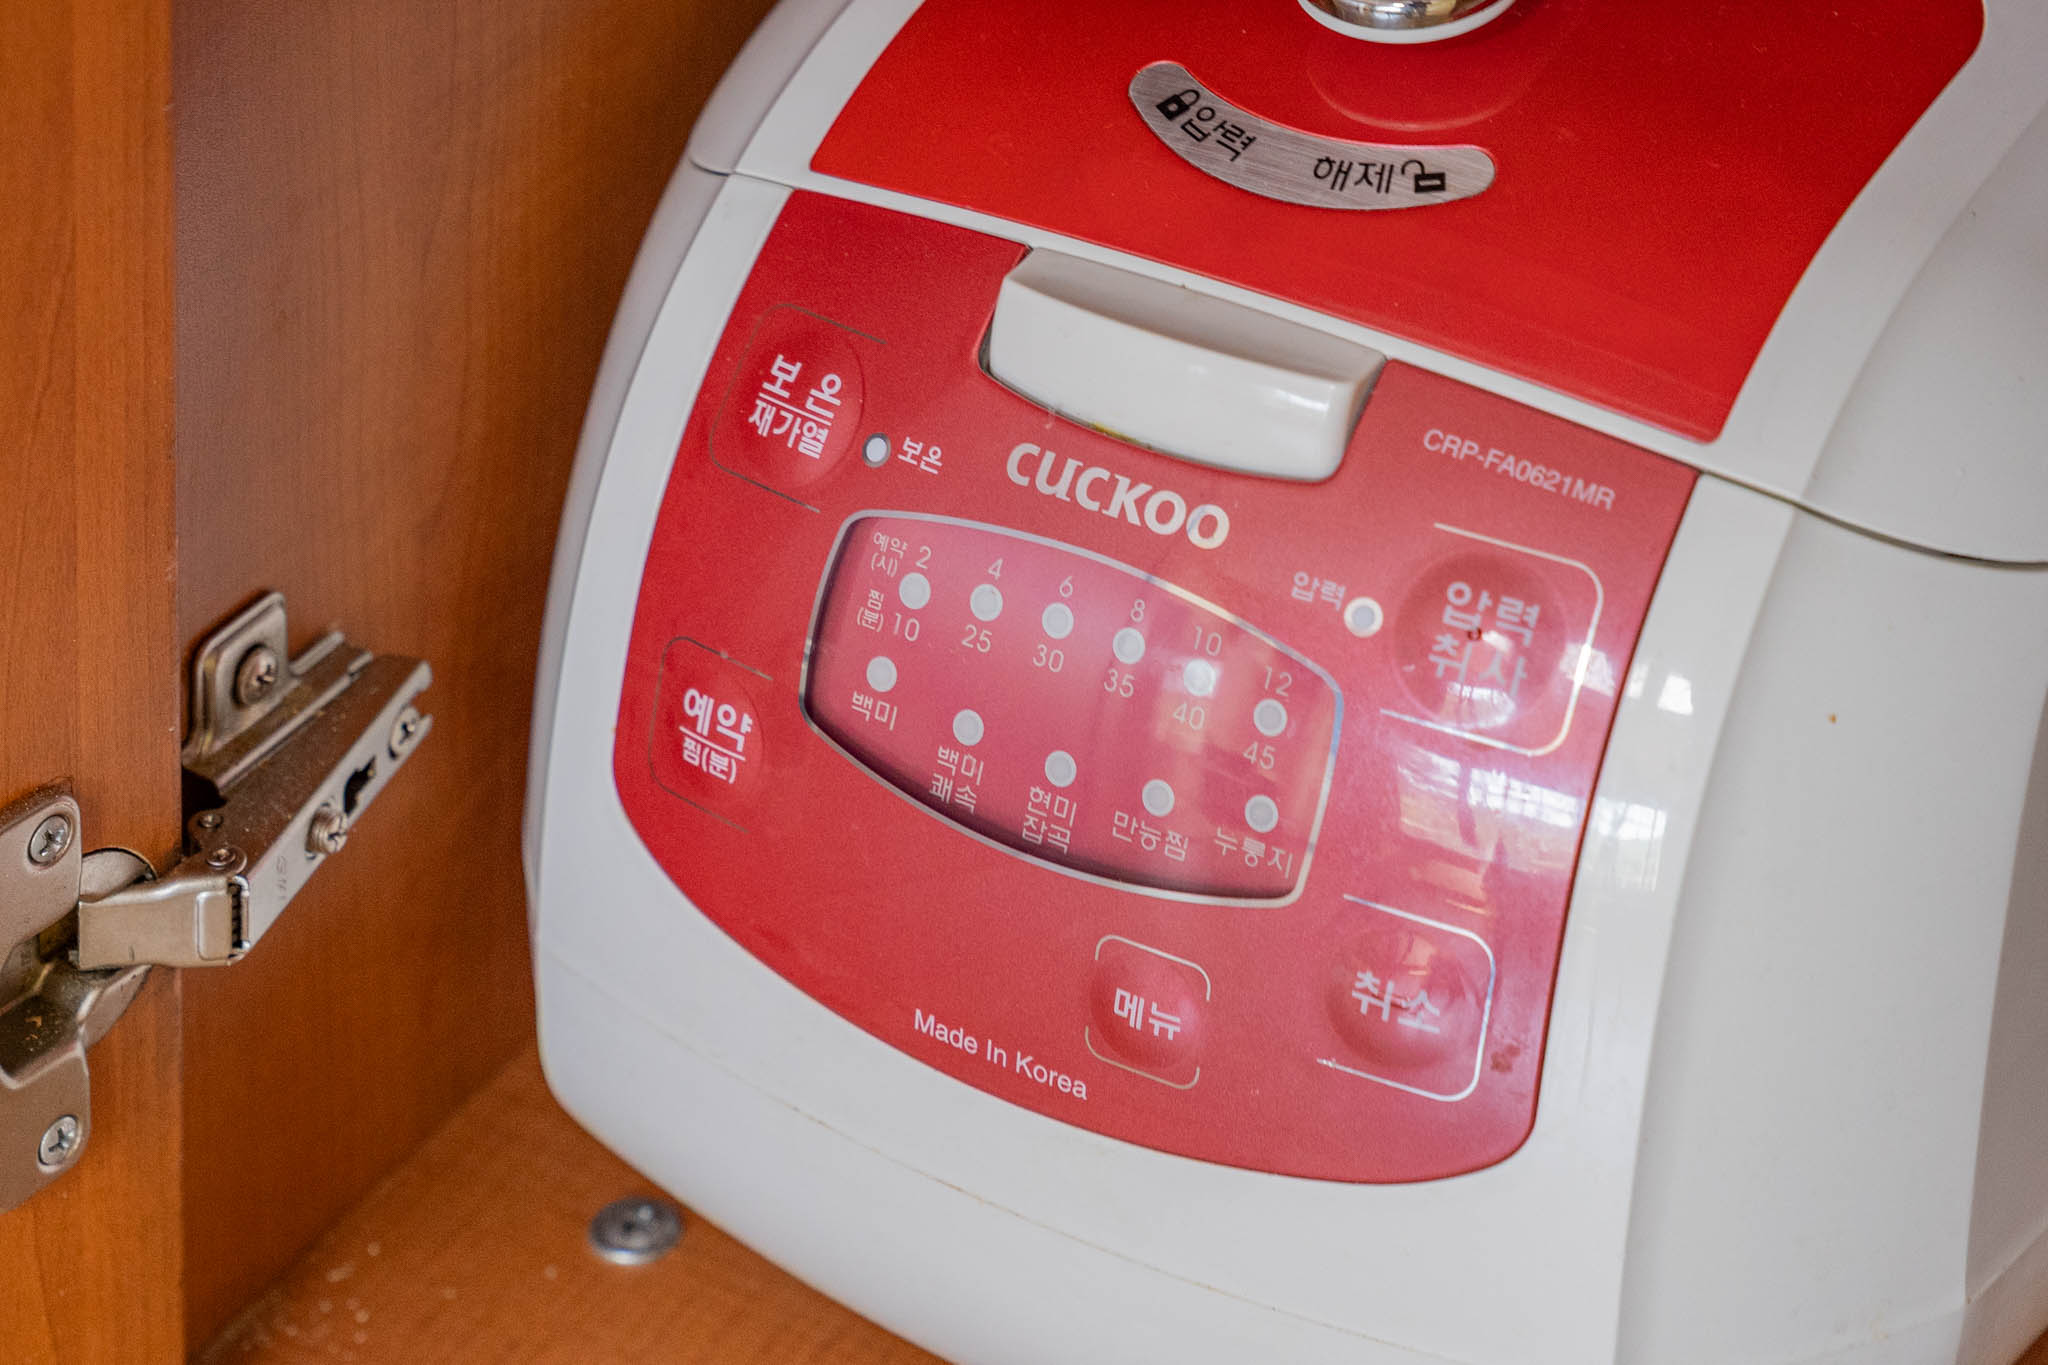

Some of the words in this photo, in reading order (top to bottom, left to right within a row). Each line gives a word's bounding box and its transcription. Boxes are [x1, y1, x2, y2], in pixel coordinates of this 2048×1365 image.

[1181, 106, 1257, 163] 압력
[1313, 156, 1396, 195] 해제
[762, 354, 842, 419] 보온
[748, 400, 829, 460] 재가열
[898, 436, 943, 475] 보온
[1423, 428, 1616, 511] CRP-FA0621MR
[1006, 442, 1230, 550] CUCKOO
[871, 553, 898, 577] (시)
[873, 532, 908, 558] 예약
[915, 546, 932, 569] 2
[988, 558, 1004, 580] 4
[1059, 576, 1074, 598] 6
[1130, 599, 1146, 623] 8
[1291, 571, 1347, 612] 압력
[893, 613, 920, 641] 10
[1442, 582, 1540, 648] 압력
[961, 624, 993, 653] 25
[1032, 644, 1065, 673] 30
[1193, 626, 1222, 656] 10
[1103, 669, 1135, 698] 35
[1263, 666, 1292, 696] 12
[683, 688, 753, 752] 예약
[851, 690, 897, 731] 백미
[1172, 703, 1206, 731] 40
[682, 736, 737, 784] 찜(분)
[937, 745, 984, 786] 백미
[1242, 741, 1276, 770] 45
[929, 772, 977, 814] 쾌속
[1027, 785, 1077, 827] 현미
[1021, 813, 1072, 855] 잡곡
[1112, 810, 1189, 862] 만능찜
[1214, 827, 1293, 879] 누룽지
[1113, 987, 1182, 1040] 메뉴
[1351, 970, 1441, 1034] 취소
[913, 1007, 978, 1055] Made
[985, 1038, 1008, 1068] In
[1015, 1050, 1088, 1101] Korea
